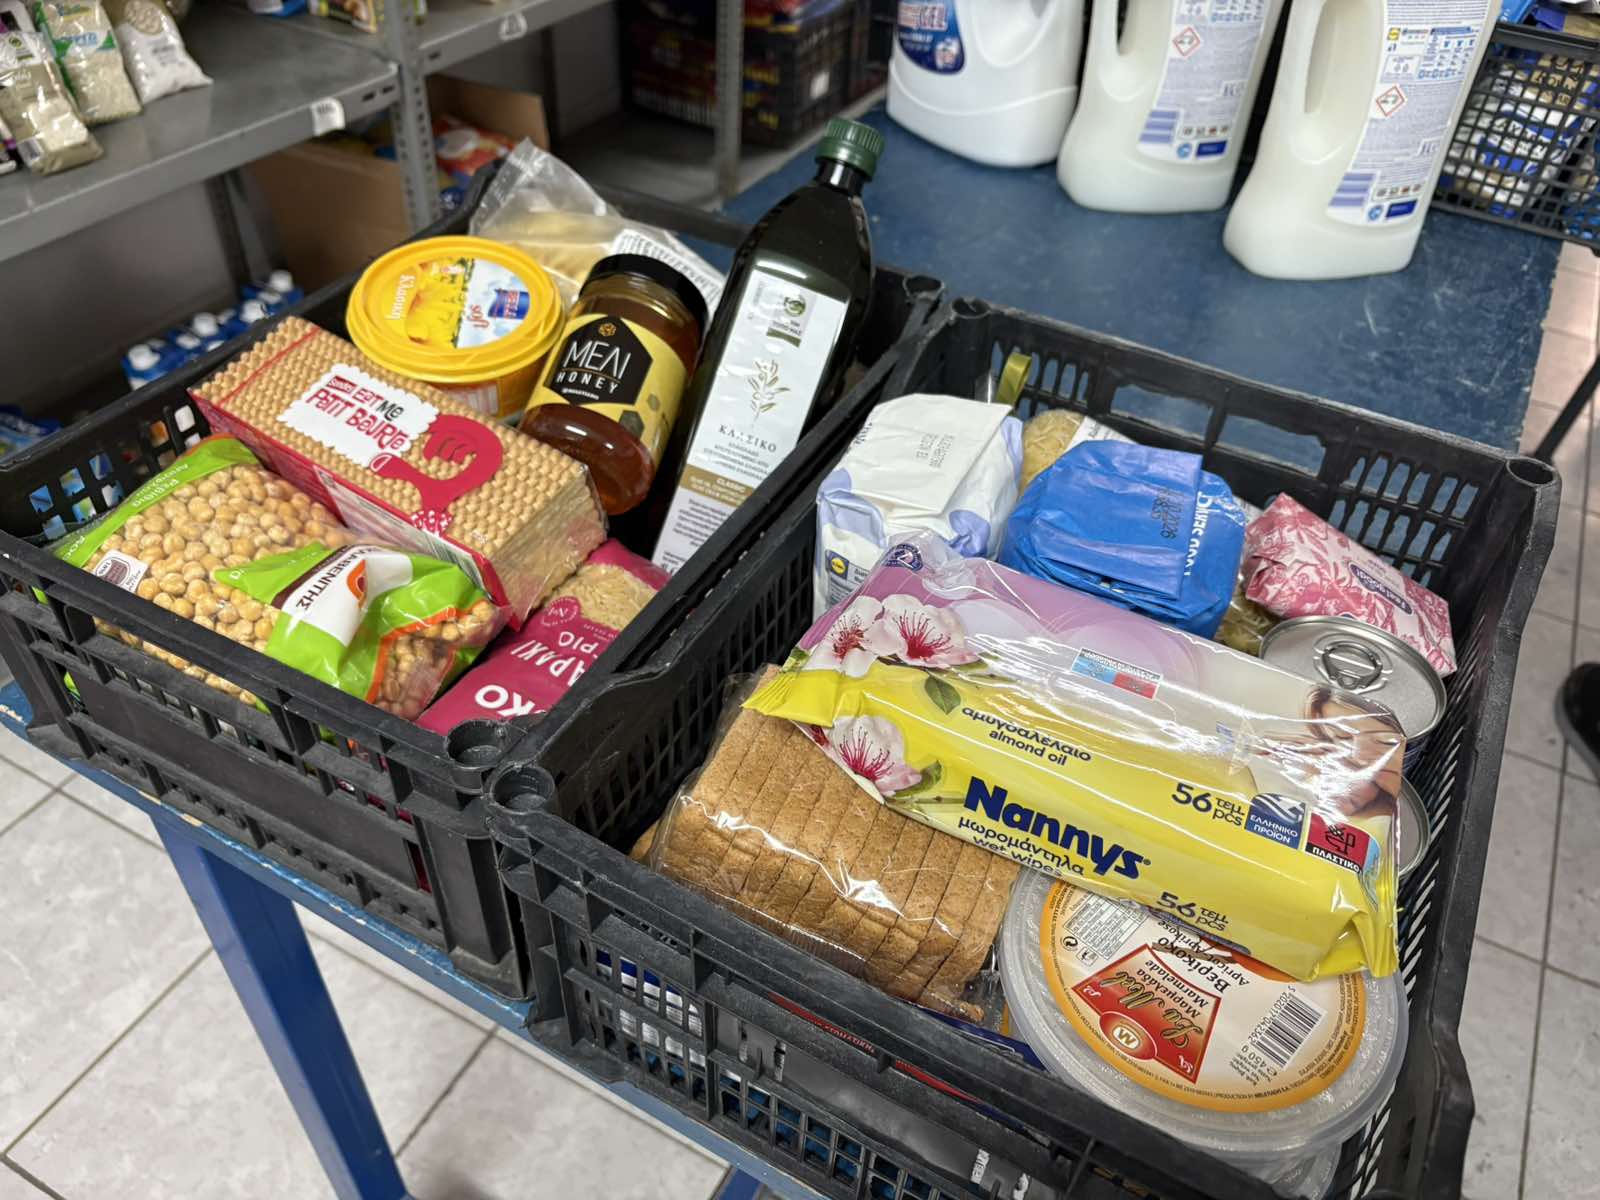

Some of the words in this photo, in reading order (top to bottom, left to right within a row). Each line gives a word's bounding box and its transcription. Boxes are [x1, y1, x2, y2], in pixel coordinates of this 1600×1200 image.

[467, 303, 490, 329] soft
[556, 371, 619, 395] HONEY
[988, 729, 1045, 757] almond
[1048, 752, 1068, 767] oil
[1171, 782, 1213, 813] 56
[963, 776, 1145, 880] Nannys
[1211, 808, 1244, 827] pcs
[1249, 814, 1299, 838] ΕΛΛΗΝΙΚΟ
[957, 816, 1085, 876] μωρομάντηλα
[972, 835, 1009, 856] wet
[1011, 850, 1066, 878] wipes
[1311, 846, 1361, 873] ΠΛΑΣΤΙΚΟ
[1156, 890, 1197, 918] 56
[1156, 919, 1207, 957] Aprikose
[1195, 916, 1227, 932] pcs
[1157, 935, 1233, 995] Βερίκοκο
[1208, 954, 1250, 986] Apricot
[1144, 959, 1209, 1008] Marmelade
[1147, 966, 1202, 1020] Μαρμελάδα
